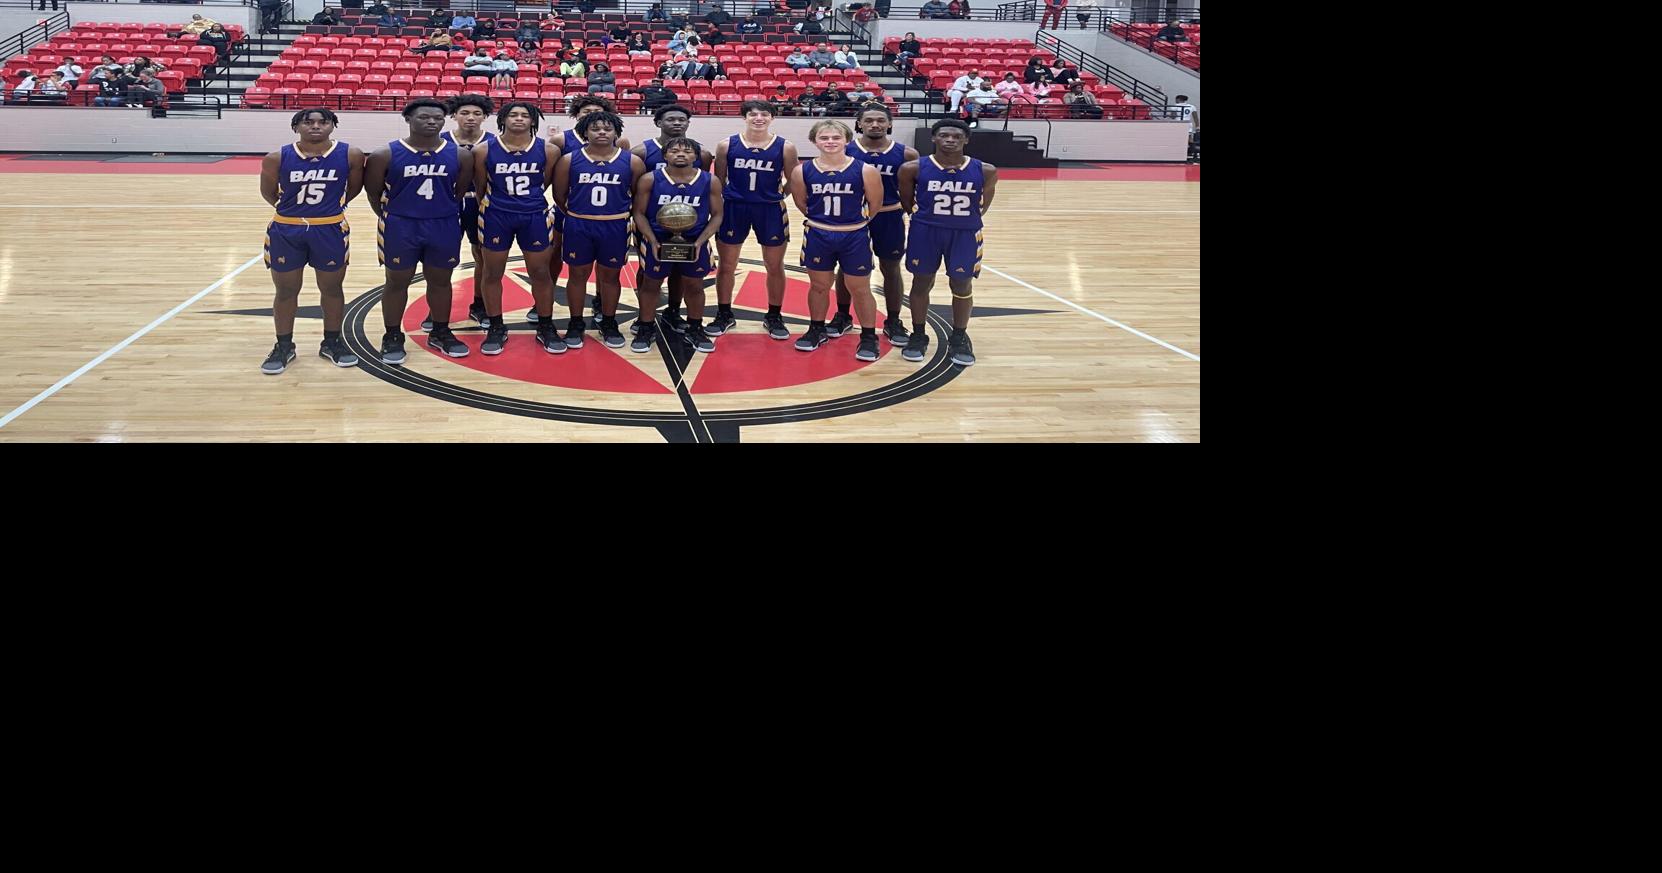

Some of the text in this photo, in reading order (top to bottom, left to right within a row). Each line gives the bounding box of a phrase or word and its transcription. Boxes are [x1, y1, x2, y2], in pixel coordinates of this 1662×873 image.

[403, 164, 448, 178] BALL
[495, 162, 540, 174] BALL
[735, 157, 774, 172] BALL
[869, 163, 894, 176] LL
[289, 169, 339, 183] BALL
[578, 172, 621, 185] BALL
[749, 171, 757, 191] 1
[416, 178, 434, 200] 4
[505, 175, 530, 196] 12
[811, 182, 854, 195] BALL
[927, 180, 976, 194] BALL
[296, 183, 326, 205] 15
[590, 186, 608, 207] 0
[657, 194, 701, 207] BALL
[823, 196, 841, 217] 11
[933, 194, 971, 216] 22
